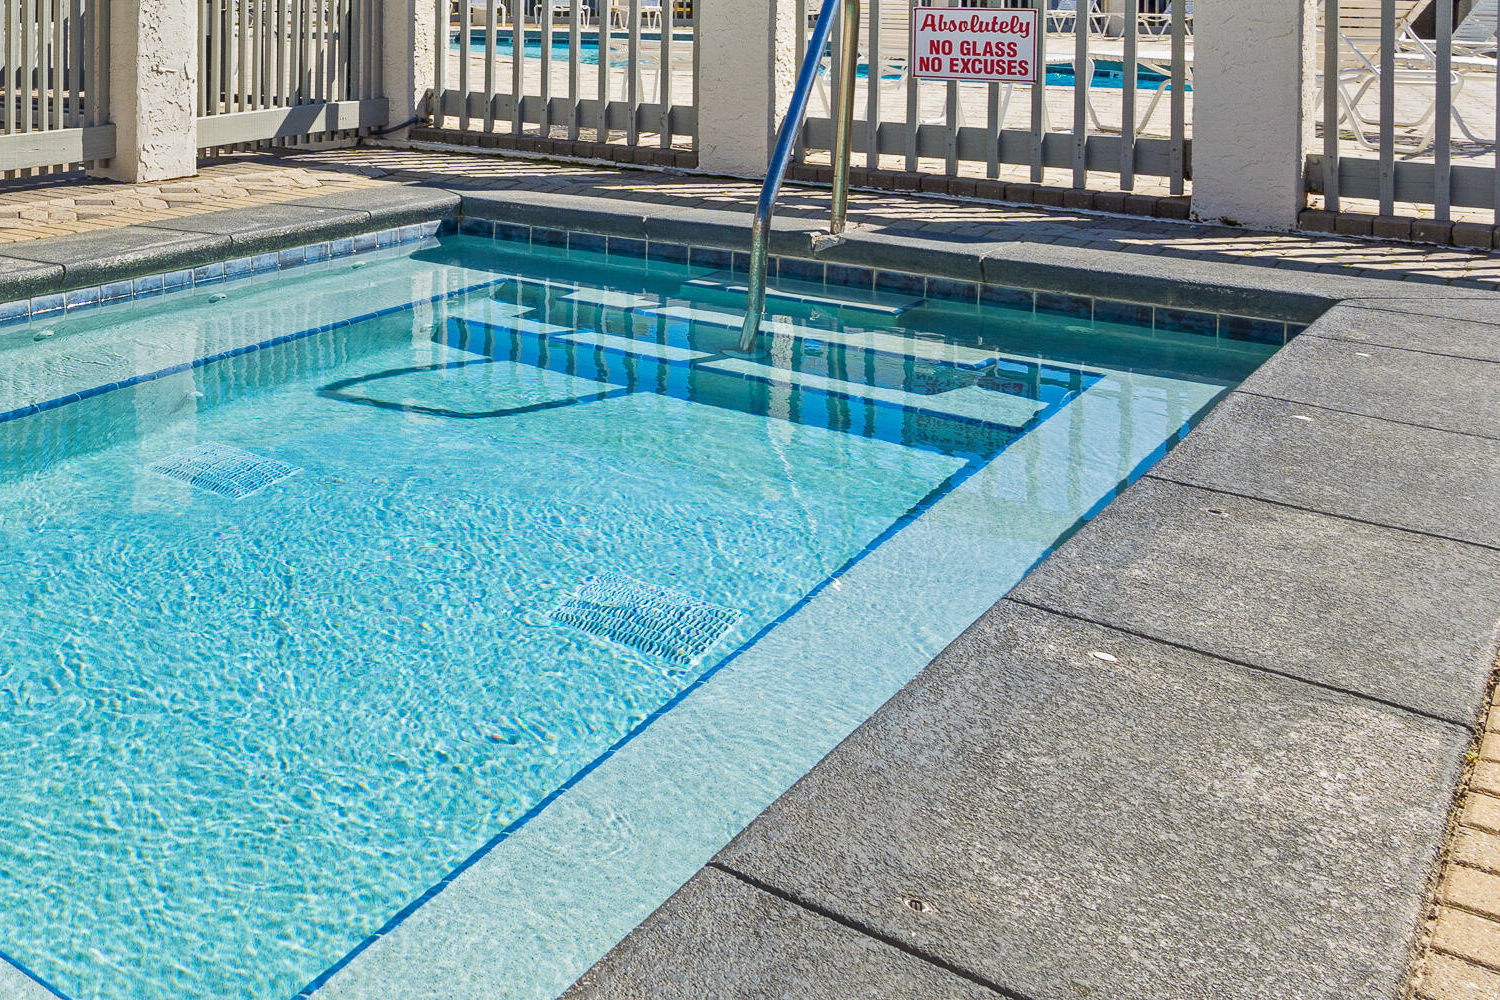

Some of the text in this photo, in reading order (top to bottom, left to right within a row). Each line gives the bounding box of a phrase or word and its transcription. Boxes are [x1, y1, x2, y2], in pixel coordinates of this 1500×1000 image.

[920, 13, 1031, 39] Absolutely
[929, 40, 1018, 58] NO GLASS
[919, 57, 1029, 76] NO EXCUSES
